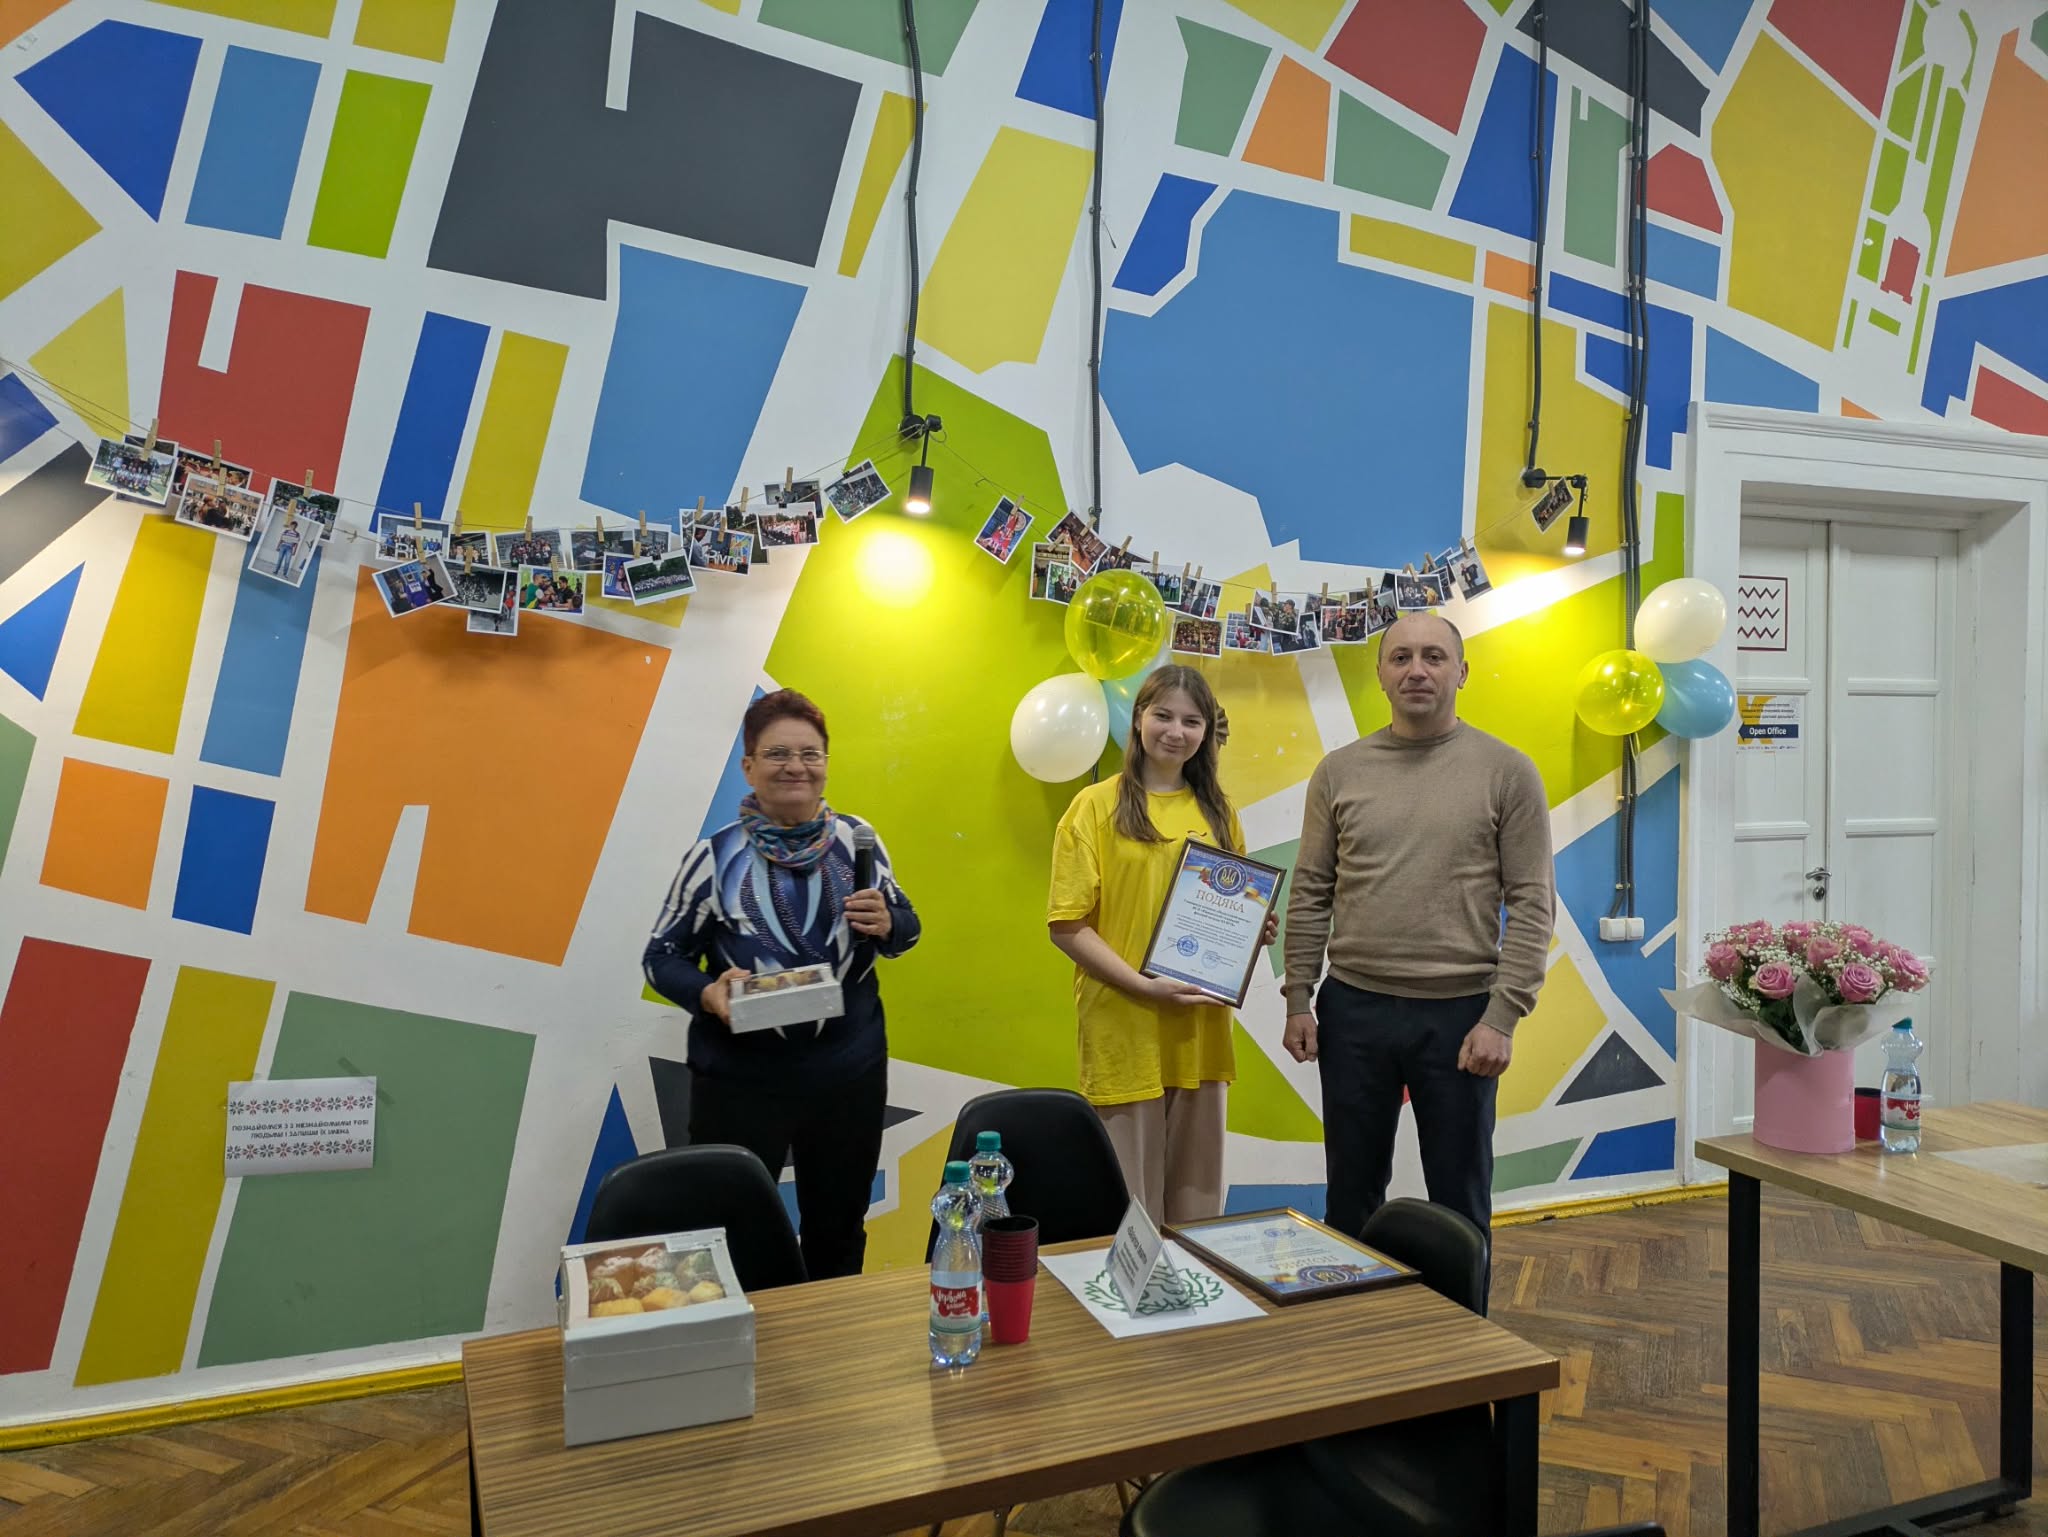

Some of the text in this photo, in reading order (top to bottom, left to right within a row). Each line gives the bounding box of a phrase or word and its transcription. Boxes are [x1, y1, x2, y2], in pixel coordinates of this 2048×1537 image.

[1749, 727, 1786, 736] Open Office
[1196, 890, 1244, 913] ПОДЯКА
[295, 1120, 351, 1128] НЕЗНАЙОМИМИ
